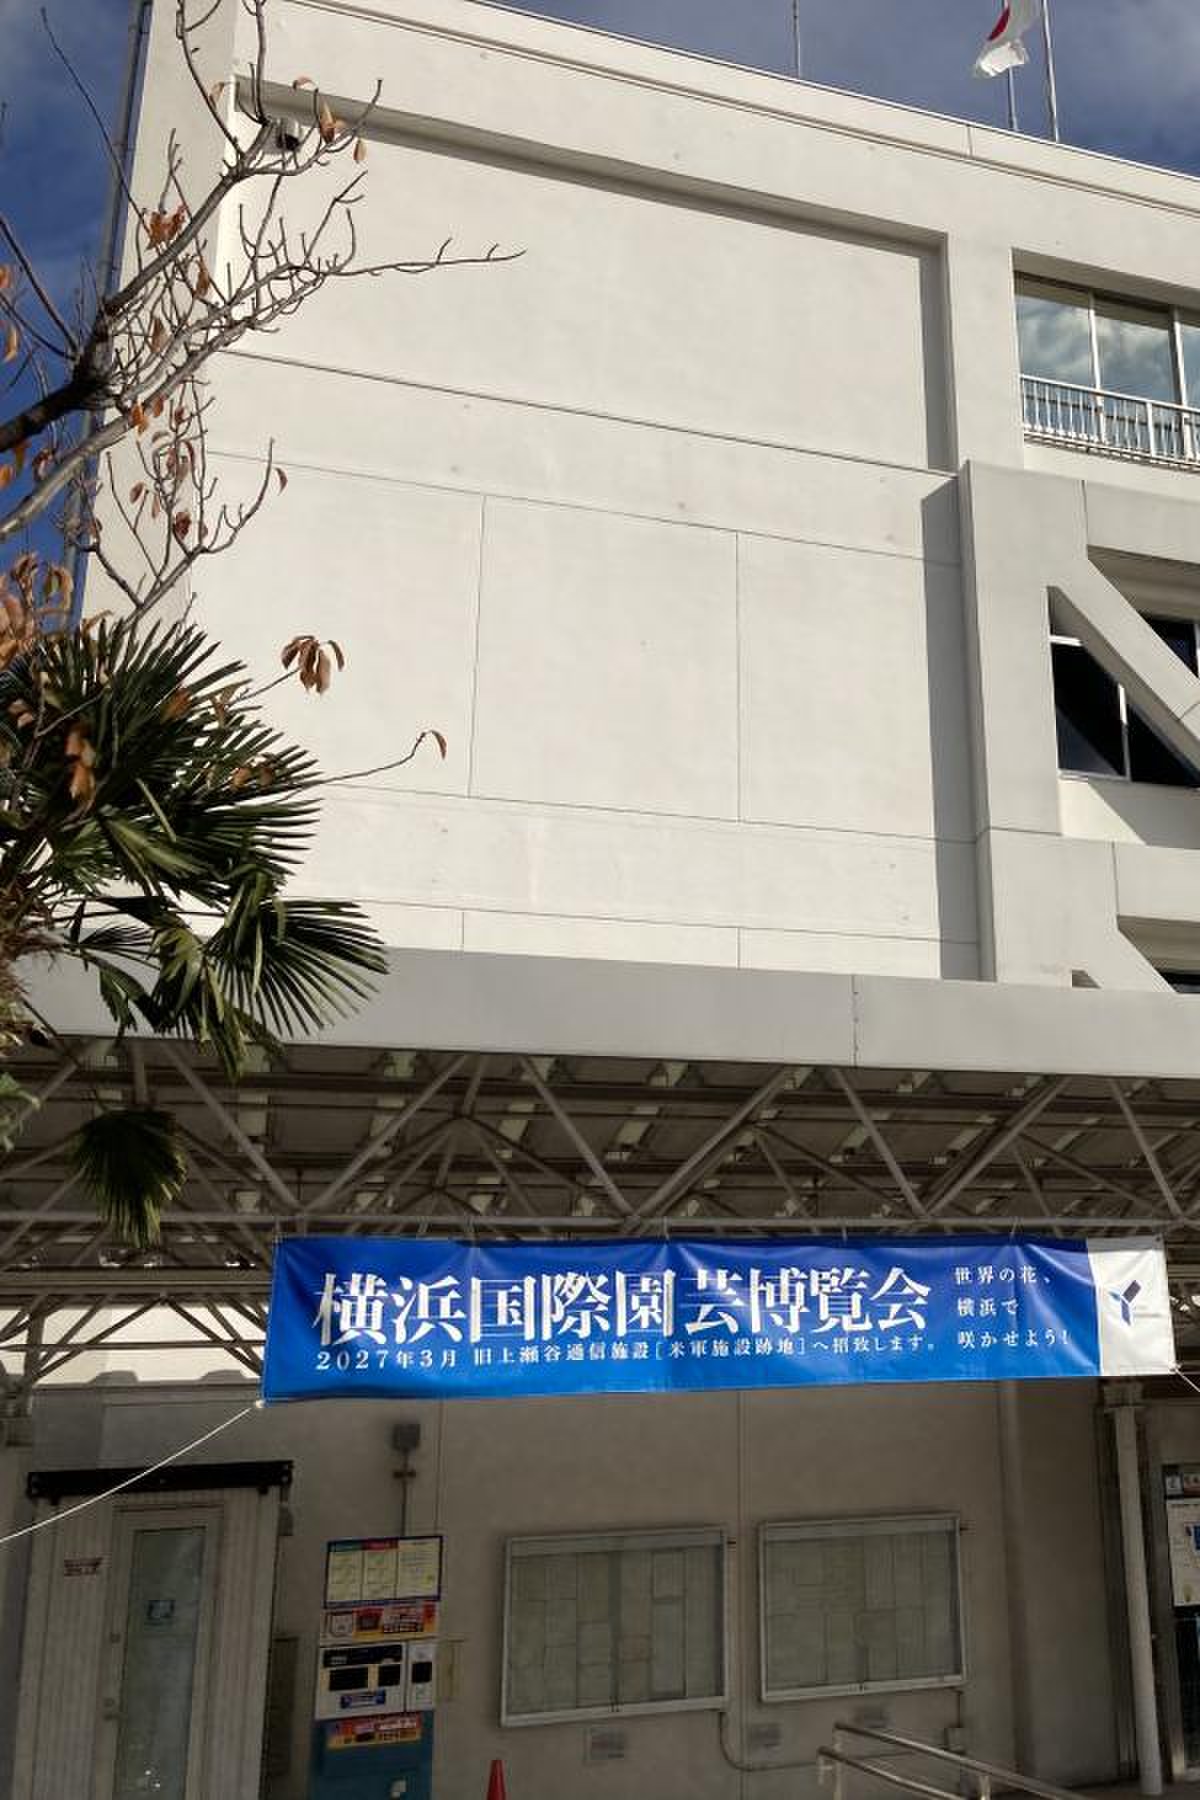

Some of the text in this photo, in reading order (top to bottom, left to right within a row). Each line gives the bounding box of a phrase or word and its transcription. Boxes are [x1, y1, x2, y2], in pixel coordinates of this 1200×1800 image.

[313, 1266, 931, 1347] 横浜国際園芸博覧会
[956, 1298, 1020, 1318] 横浜で
[316, 1348, 458, 1372] 2027年3月
